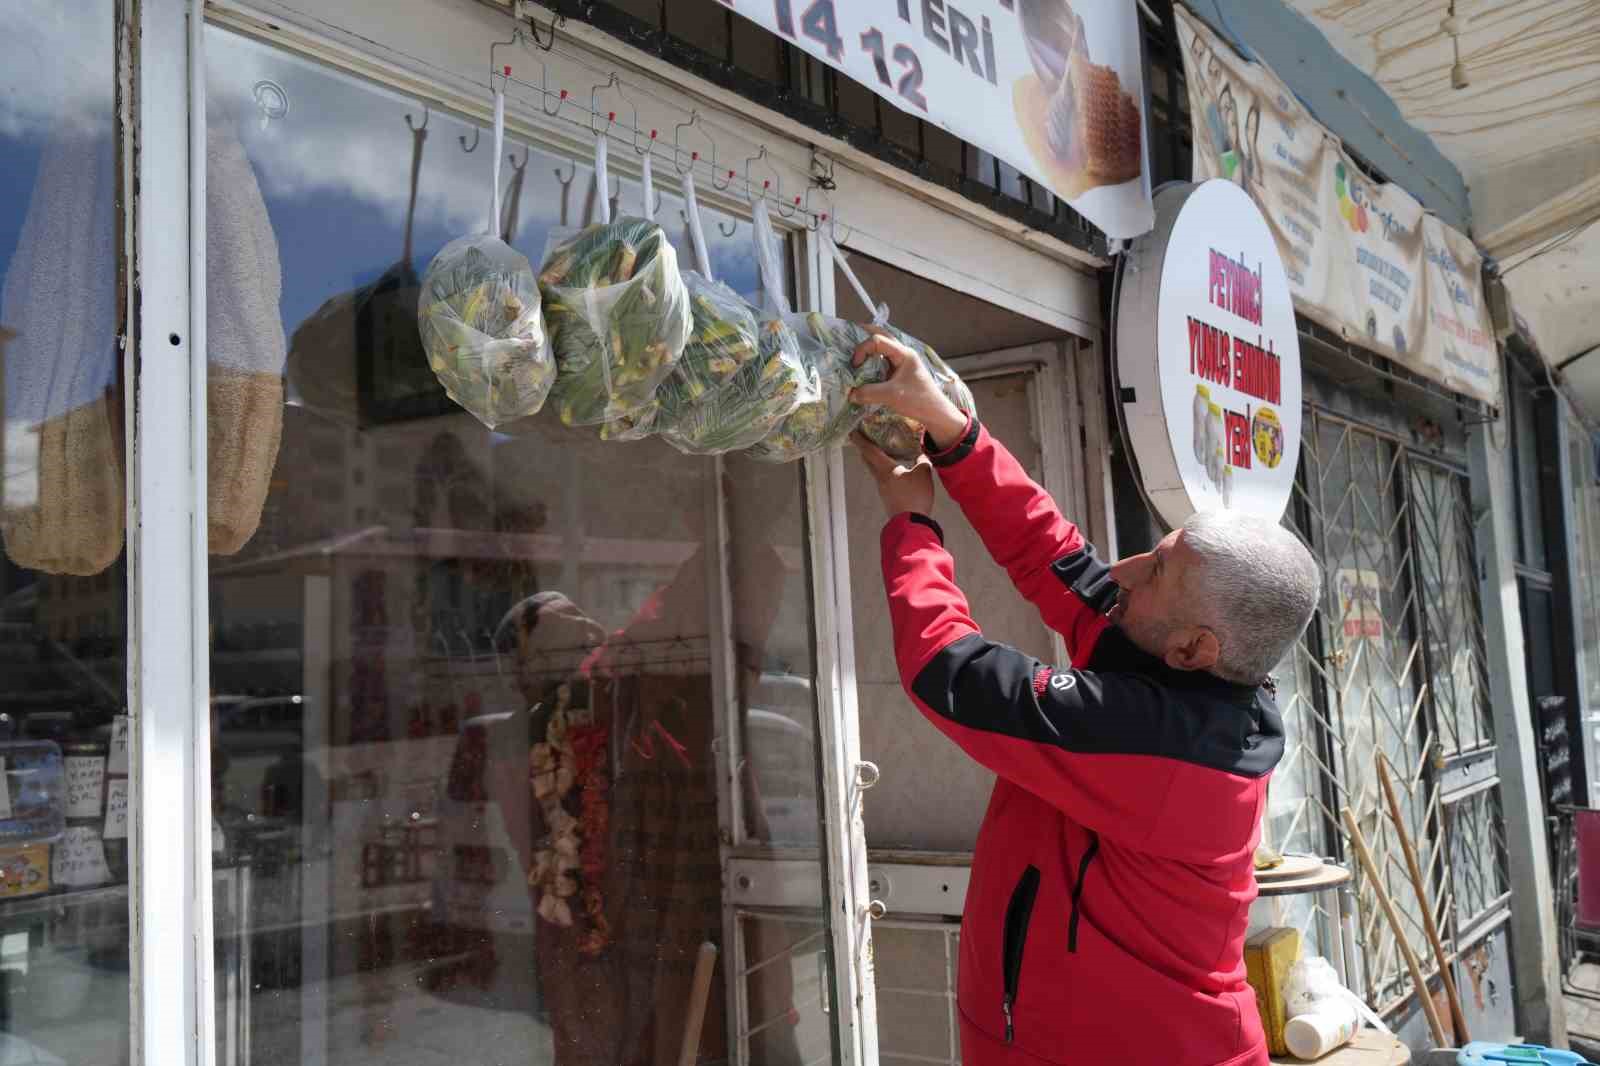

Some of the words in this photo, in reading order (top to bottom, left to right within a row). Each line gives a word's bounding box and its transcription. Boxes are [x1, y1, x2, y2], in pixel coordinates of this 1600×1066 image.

[859, 26, 929, 113] 12
[1187, 315, 1230, 387] YUNUS
[1223, 403, 1251, 469] YERİ
